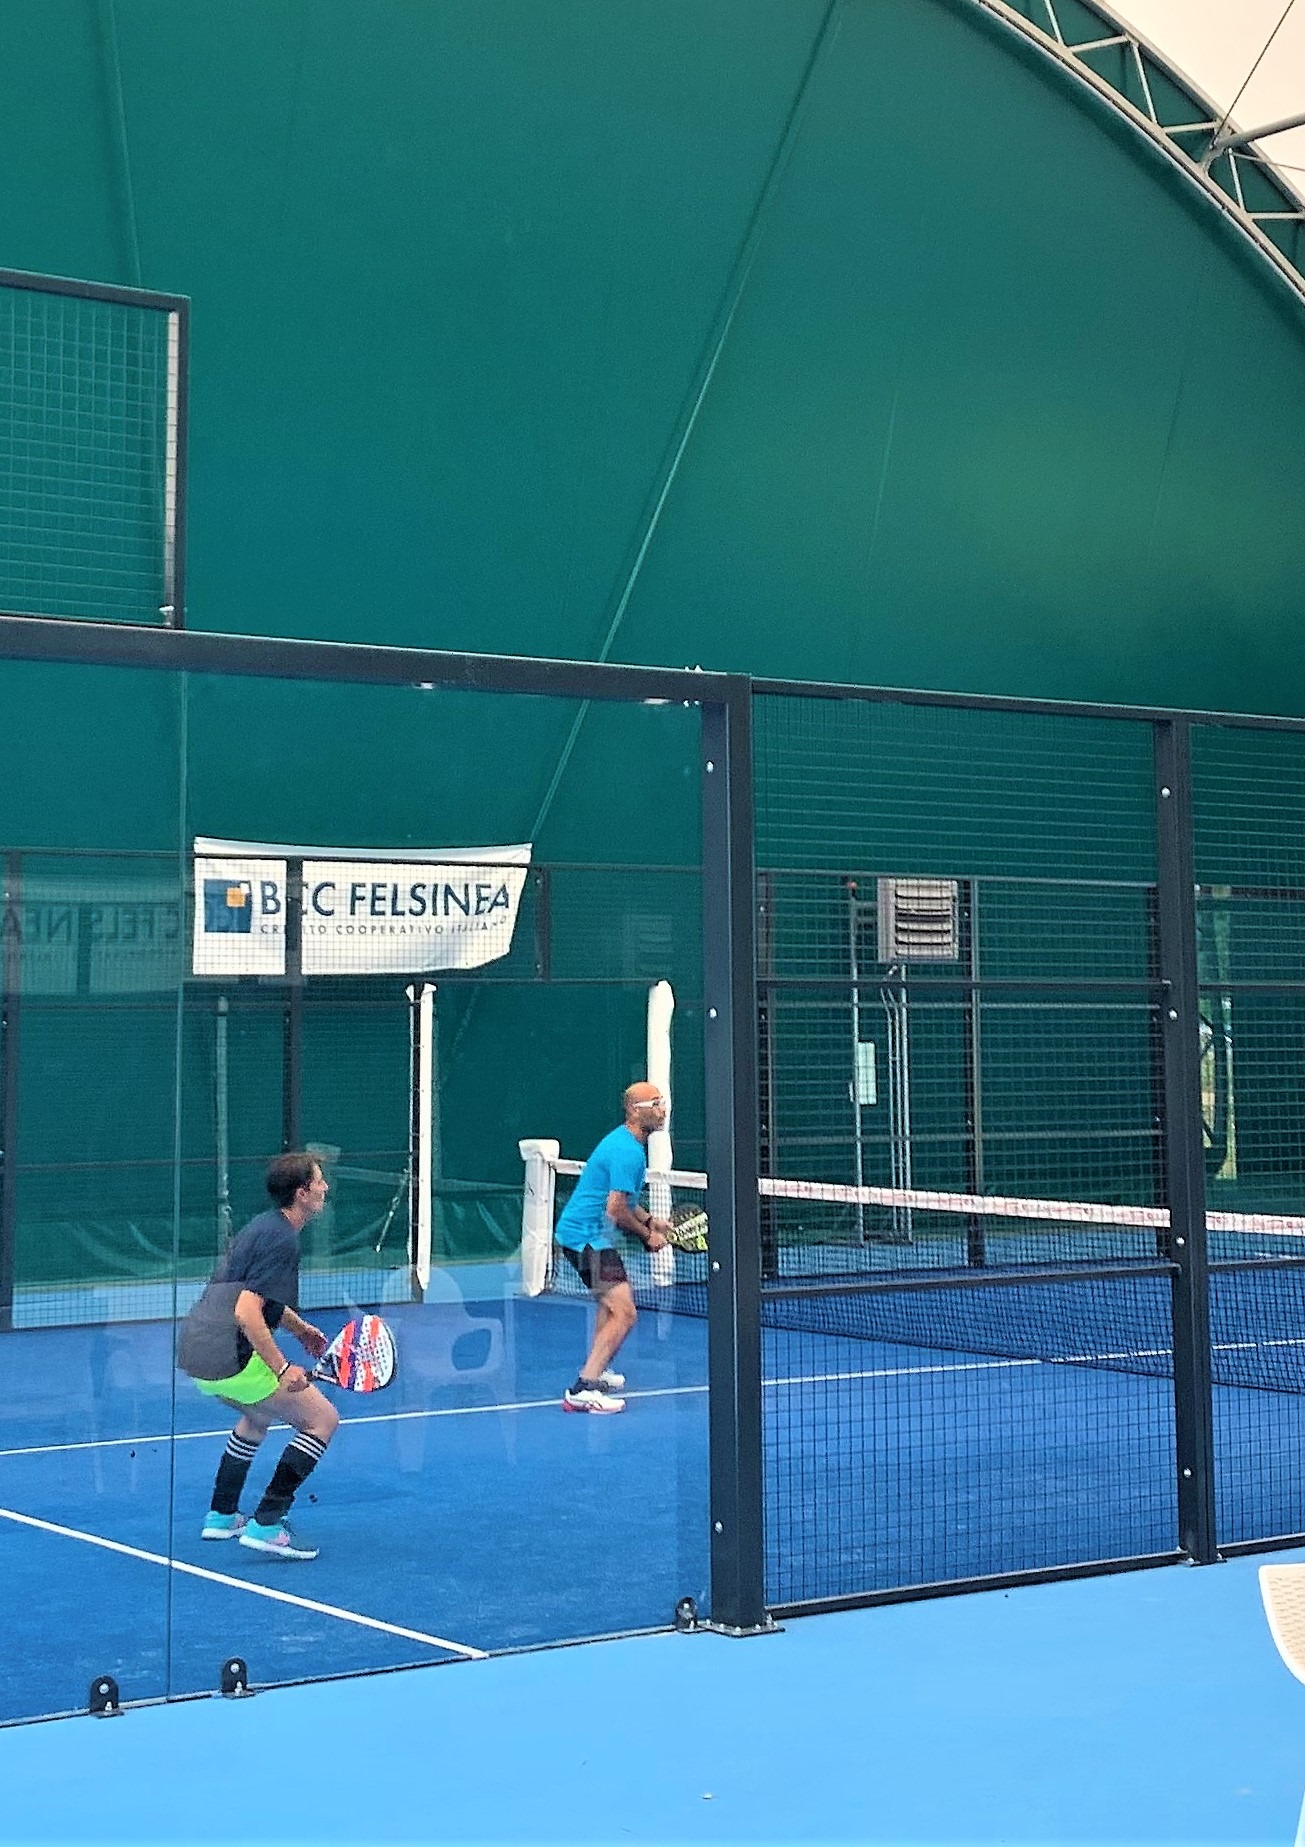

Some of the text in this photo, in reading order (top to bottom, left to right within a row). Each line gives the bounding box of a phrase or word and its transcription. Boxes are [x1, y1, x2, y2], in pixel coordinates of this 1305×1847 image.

[260, 880, 510, 917] BC FELSINEA
[260, 924, 327, 935] CRITO
[336, 924, 444, 935] COOPERATIVO
